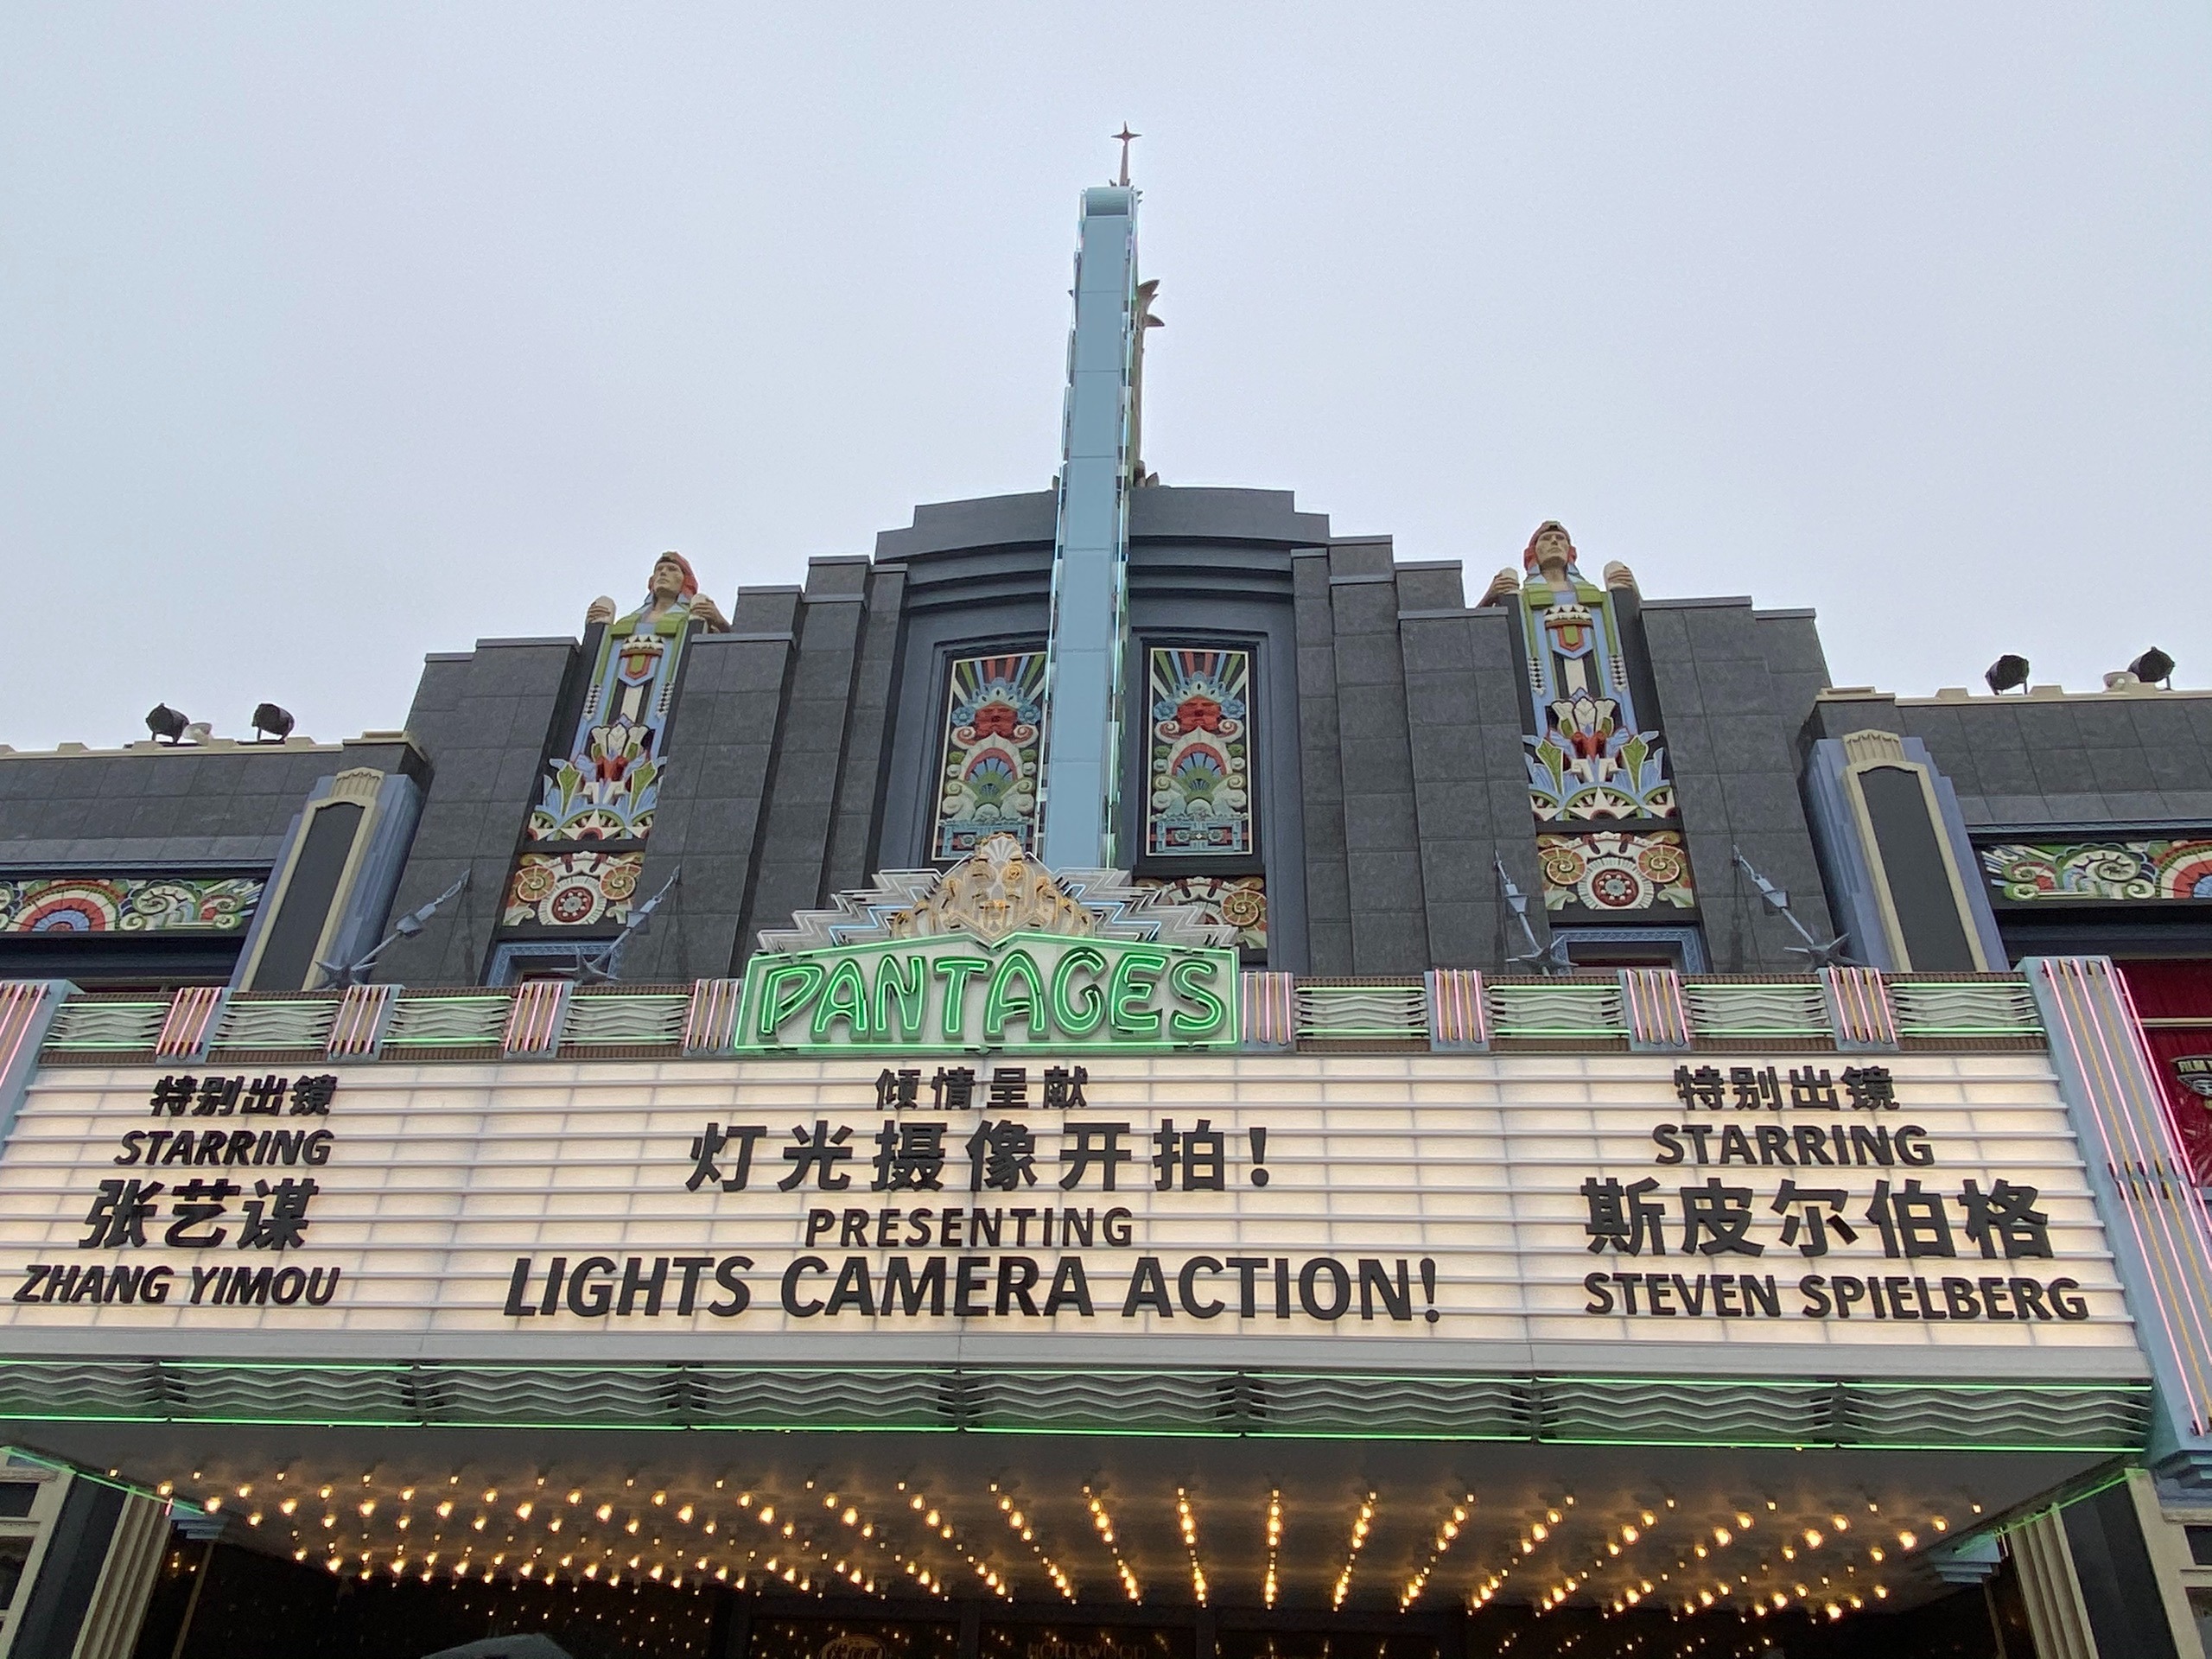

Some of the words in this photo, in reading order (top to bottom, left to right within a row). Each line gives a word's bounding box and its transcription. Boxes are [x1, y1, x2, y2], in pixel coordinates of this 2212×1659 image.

[757, 946, 1227, 1041] PANTAGES
[150, 1074, 338, 1117] 特别出镜
[874, 1066, 1089, 1111] 倾情呈献
[1674, 1065, 1900, 1112] 特别出镜
[114, 1129, 334, 1166] STARRING
[1652, 1124, 1935, 1167] STARRING
[78, 1178, 320, 1251] 张艺谋
[804, 1207, 1133, 1248] PRESENTING
[1580, 1177, 2055, 1260] 斯皮尔伯格
[12, 1264, 174, 1305] ZHANG
[189, 1266, 340, 1306] YIMOU
[503, 1255, 754, 1318] LIGHTS
[780, 1255, 1095, 1318] CAMERA
[1122, 1255, 1440, 1324] ACTION!
[1584, 1272, 1782, 1318] STEVEN
[1800, 1274, 2089, 1321] SPIELBERG
